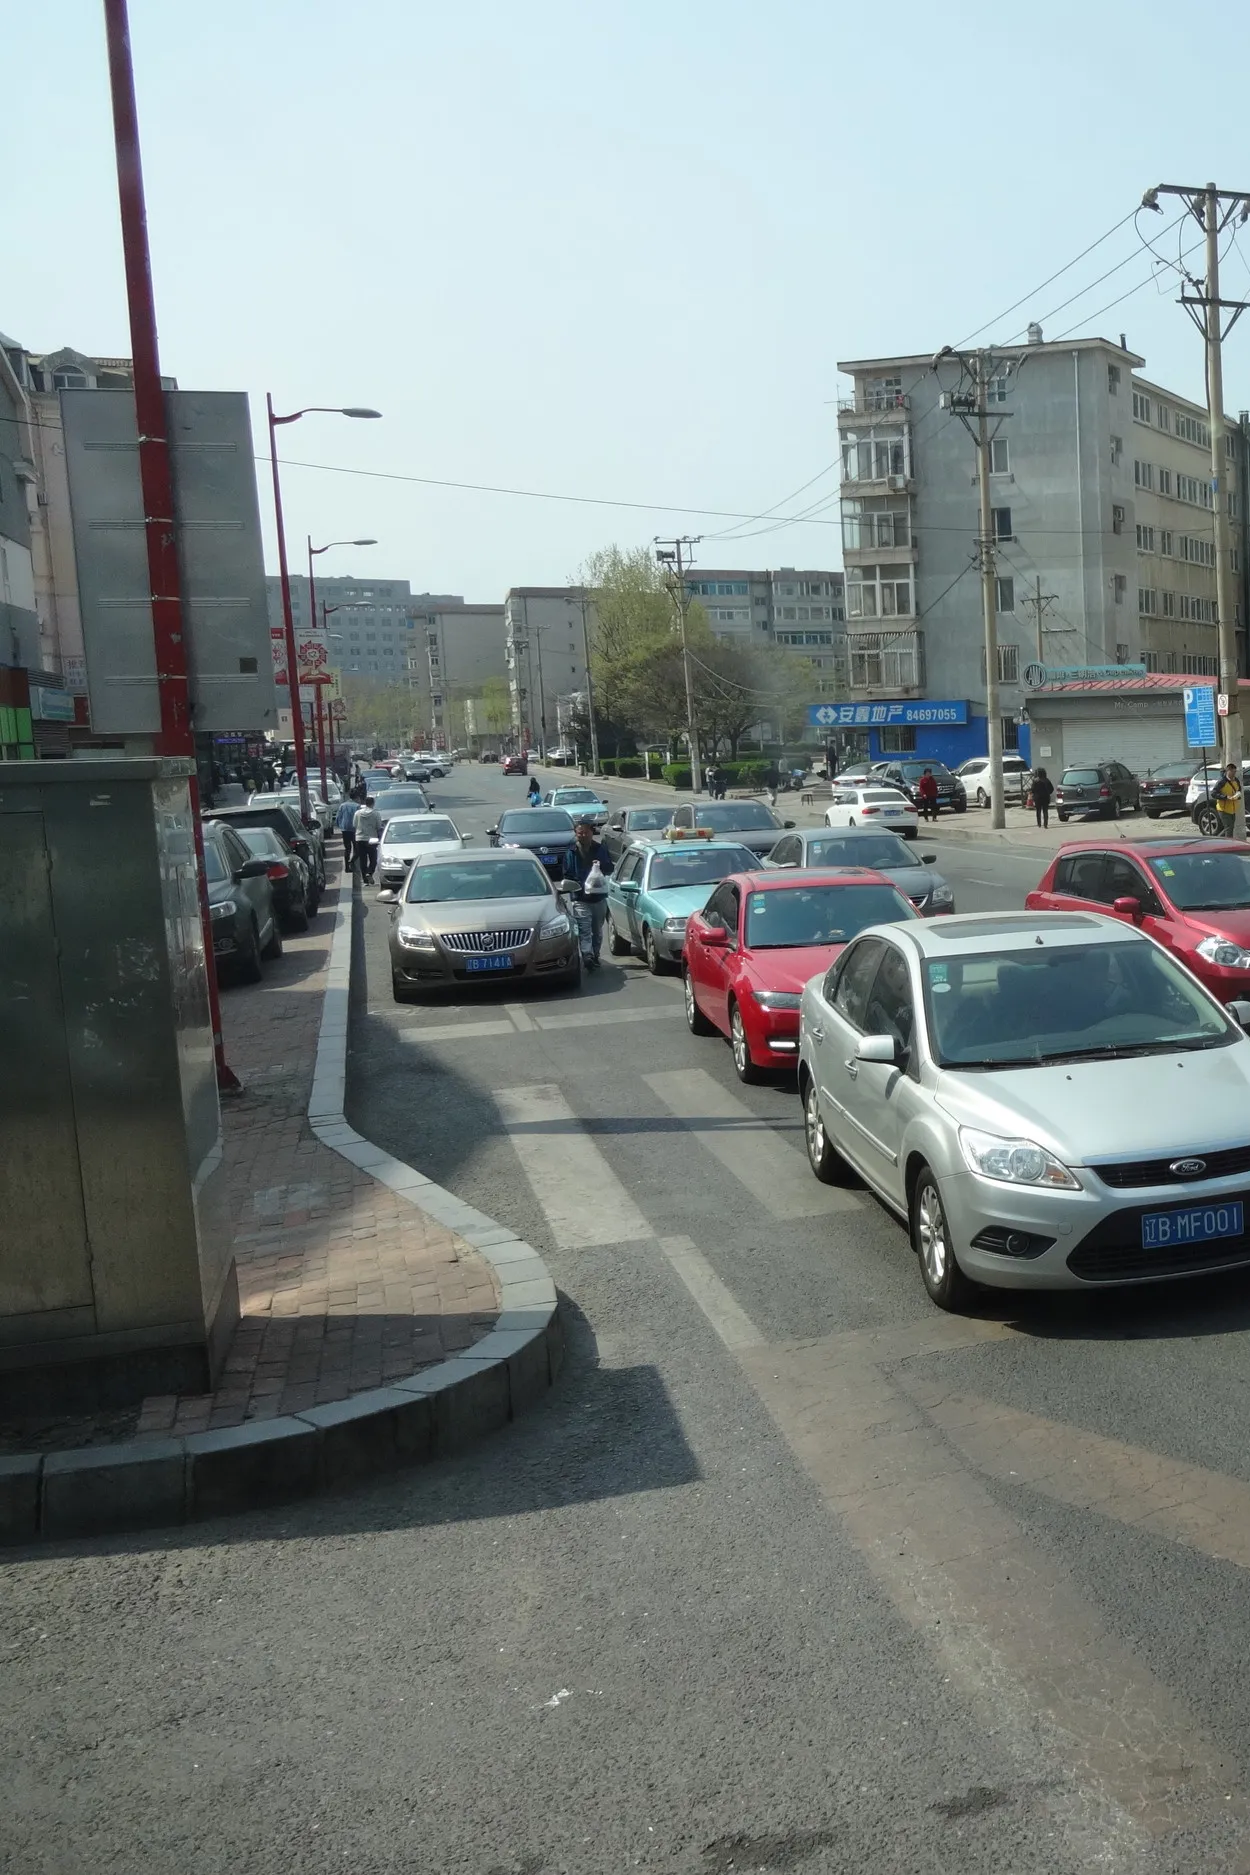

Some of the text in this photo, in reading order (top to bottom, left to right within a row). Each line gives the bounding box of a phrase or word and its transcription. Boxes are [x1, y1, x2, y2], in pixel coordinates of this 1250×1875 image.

[838, 705, 957, 723] 安鑫地产 84697055
